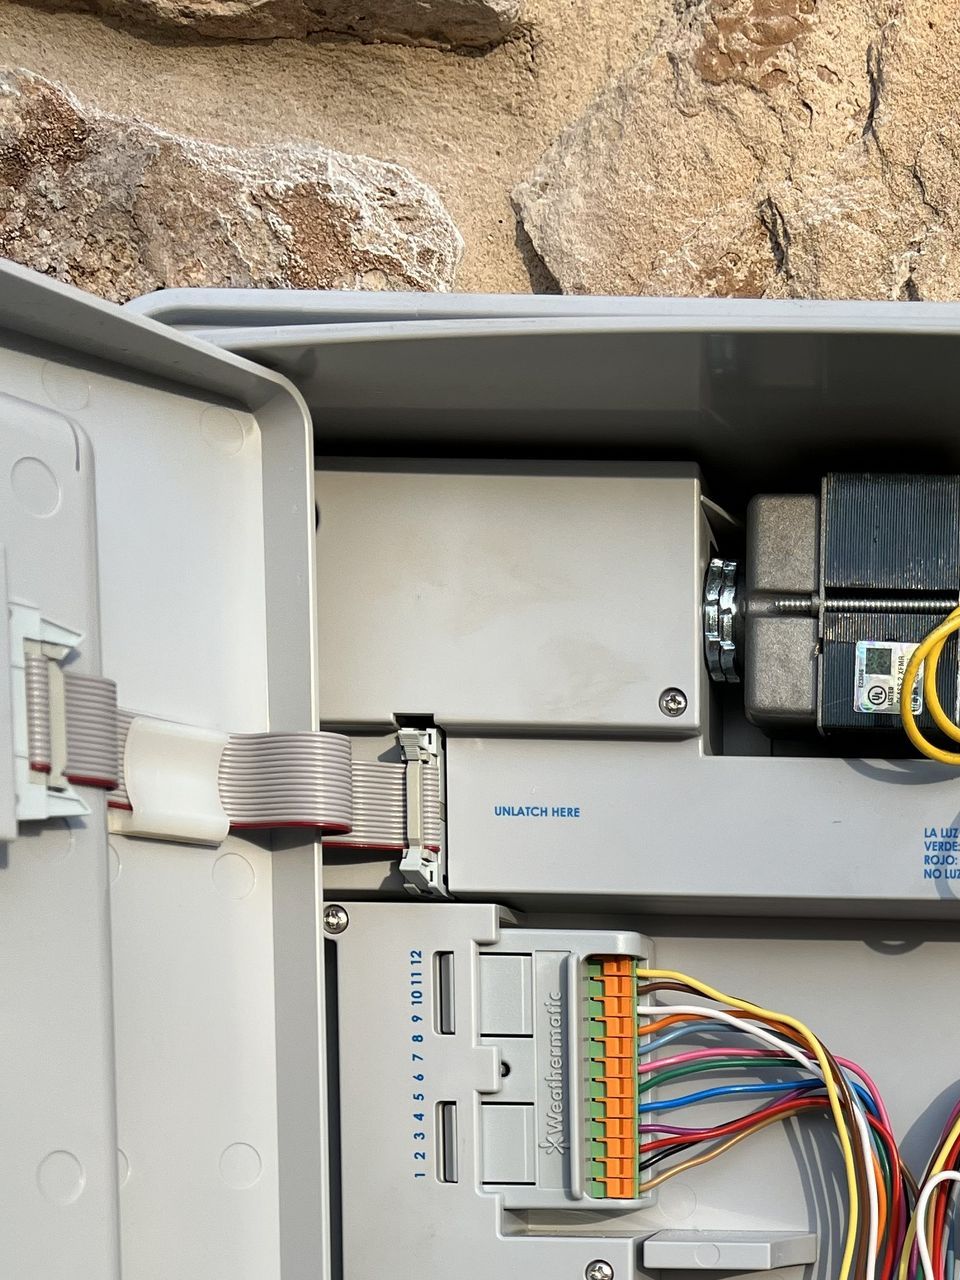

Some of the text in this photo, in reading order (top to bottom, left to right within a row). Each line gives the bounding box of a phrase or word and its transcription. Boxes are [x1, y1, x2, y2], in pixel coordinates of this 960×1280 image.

[494, 806, 580, 818] UNLATCH HERE
[924, 827, 938, 839] LA
[940, 828, 959, 839] LUZ
[924, 841, 960, 852] VERDE:
[924, 855, 958, 866] ROJO:
[923, 868, 942, 880] NO
[410, 950, 422, 965] 12
[410, 972, 422, 986] 11
[410, 990, 423, 1006] 10
[411, 1014, 423, 1023] 9
[411, 1034, 424, 1043] 8
[412, 1054, 424, 1062] 7
[545, 990, 563, 1139] Weathermatic
[412, 1073, 425, 1082] 6
[413, 1093, 425, 1101] 5
[413, 1112, 425, 1122] 4
[413, 1132, 426, 1140] 3
[414, 1151, 426, 1160] 2
